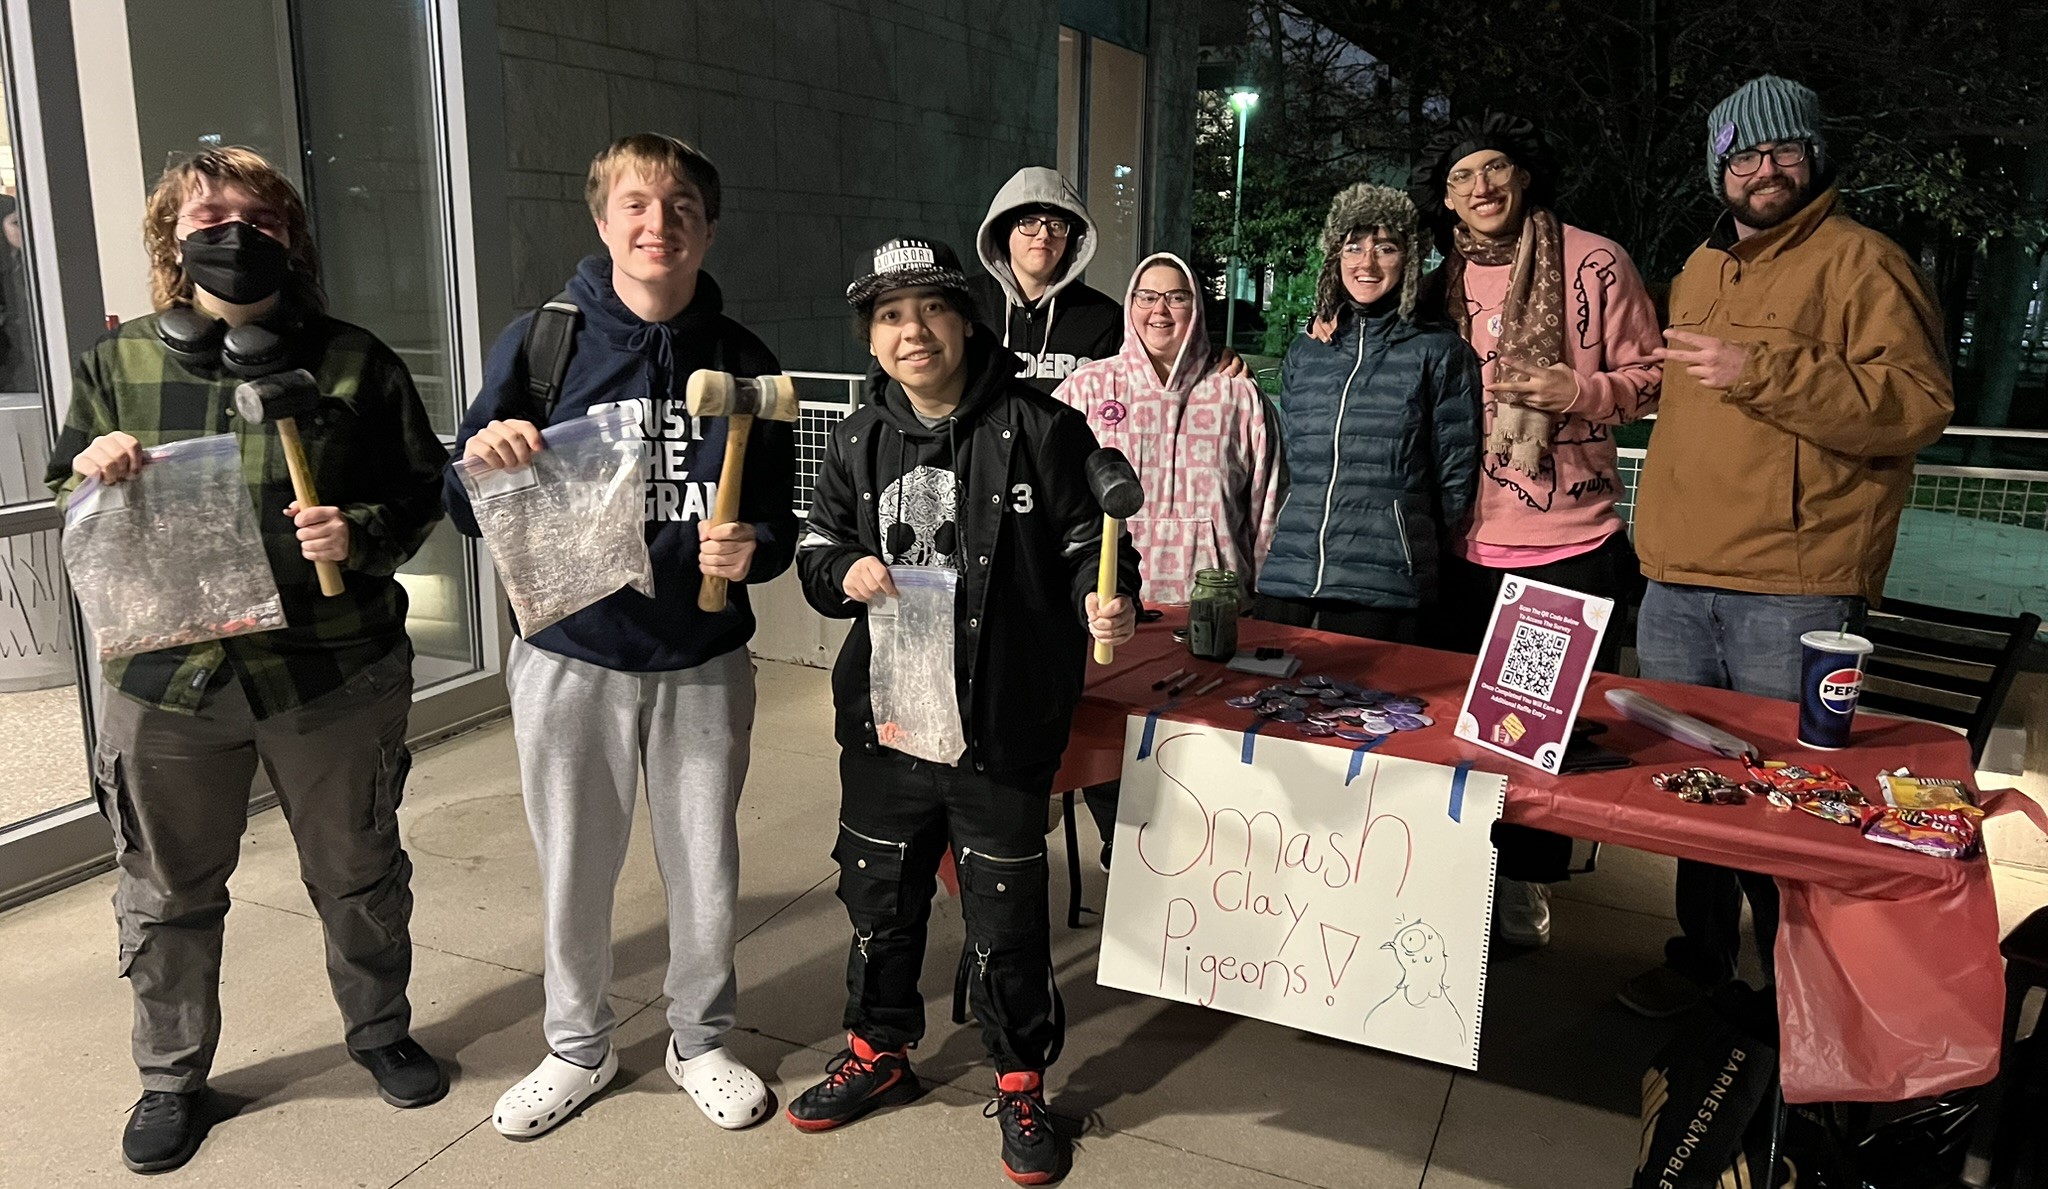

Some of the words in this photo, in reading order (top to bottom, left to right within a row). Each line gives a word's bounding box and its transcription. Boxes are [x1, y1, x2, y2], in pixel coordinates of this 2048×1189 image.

[877, 249, 932, 269] ADVISORY
[612, 440, 689, 480] THE
[1004, 484, 1034, 513] 3
[1518, 604, 1532, 613] Scan
[1549, 613, 1563, 621] Code
[1563, 617, 1580, 626] Below
[1525, 615, 1543, 625] Access
[1553, 624, 1572, 634] Survey
[1481, 682, 1495, 691] Once
[1494, 687, 1522, 701] Completed
[1521, 696, 1532, 704] You
[1532, 700, 1543, 708] Will
[1542, 703, 1556, 712] Earn
[1490, 695, 1517, 708] Additional
[1516, 704, 1532, 713] Raffle
[1531, 709, 1547, 720] Entry
[1138, 733, 1412, 897] Smash
[1213, 871, 1308, 956] Clay
